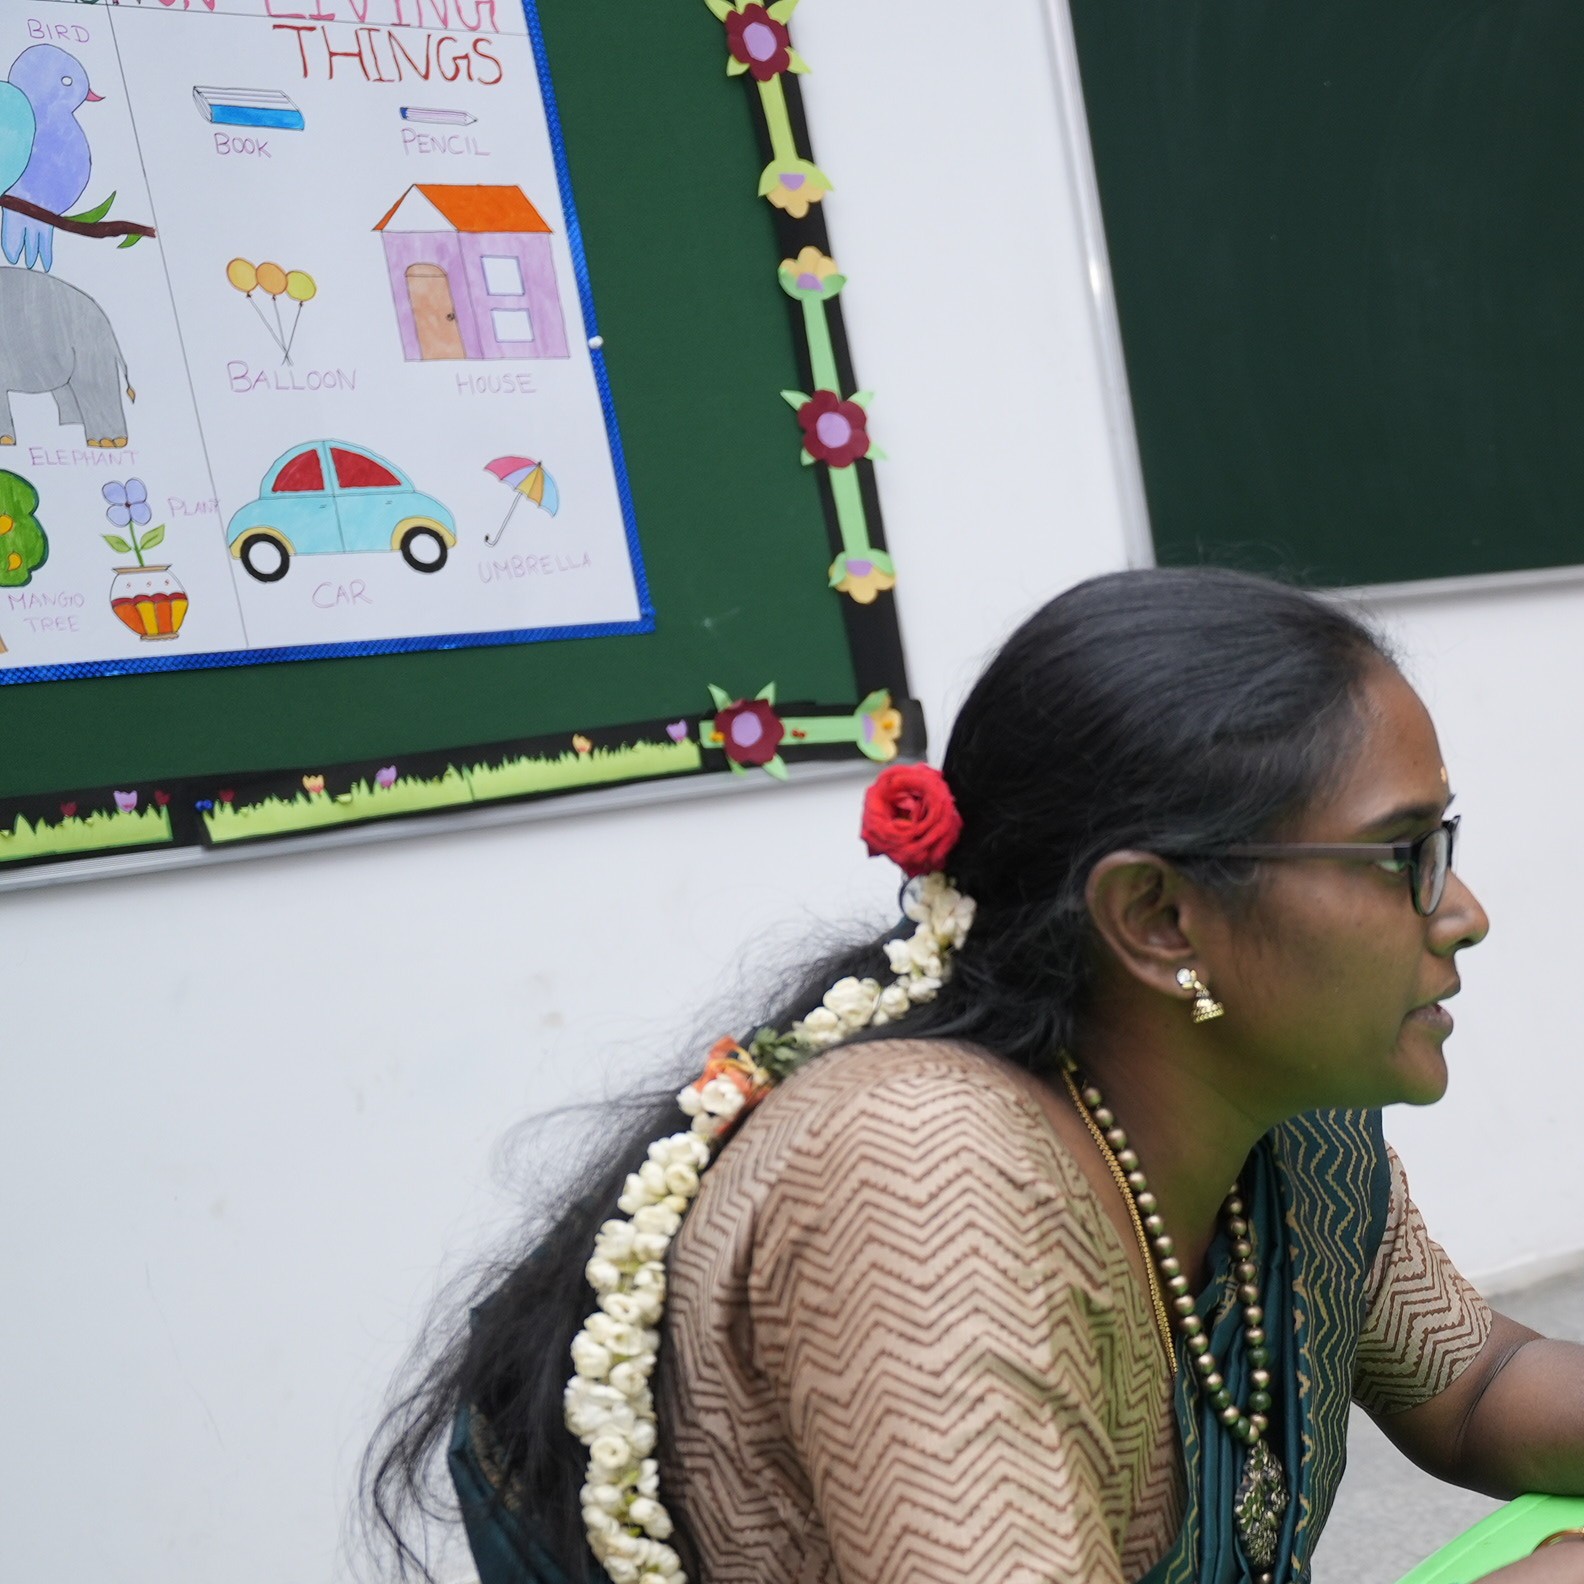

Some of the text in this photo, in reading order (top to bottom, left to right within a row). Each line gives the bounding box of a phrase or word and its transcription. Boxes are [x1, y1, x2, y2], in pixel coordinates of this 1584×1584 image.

[27, 18, 90, 43] BIRD
[273, 24, 502, 85] THINGS
[214, 132, 272, 158] BOOK
[401, 127, 490, 156] PENCIL
[226, 360, 357, 393] BALLOON
[455, 372, 537, 395] HOUSE
[28, 447, 139, 466] ELEPHANT
[478, 552, 592, 584] UMBRELLA
[8, 591, 85, 610] MANGO
[312, 578, 373, 608] CAR
[23, 615, 81, 632] TREE
